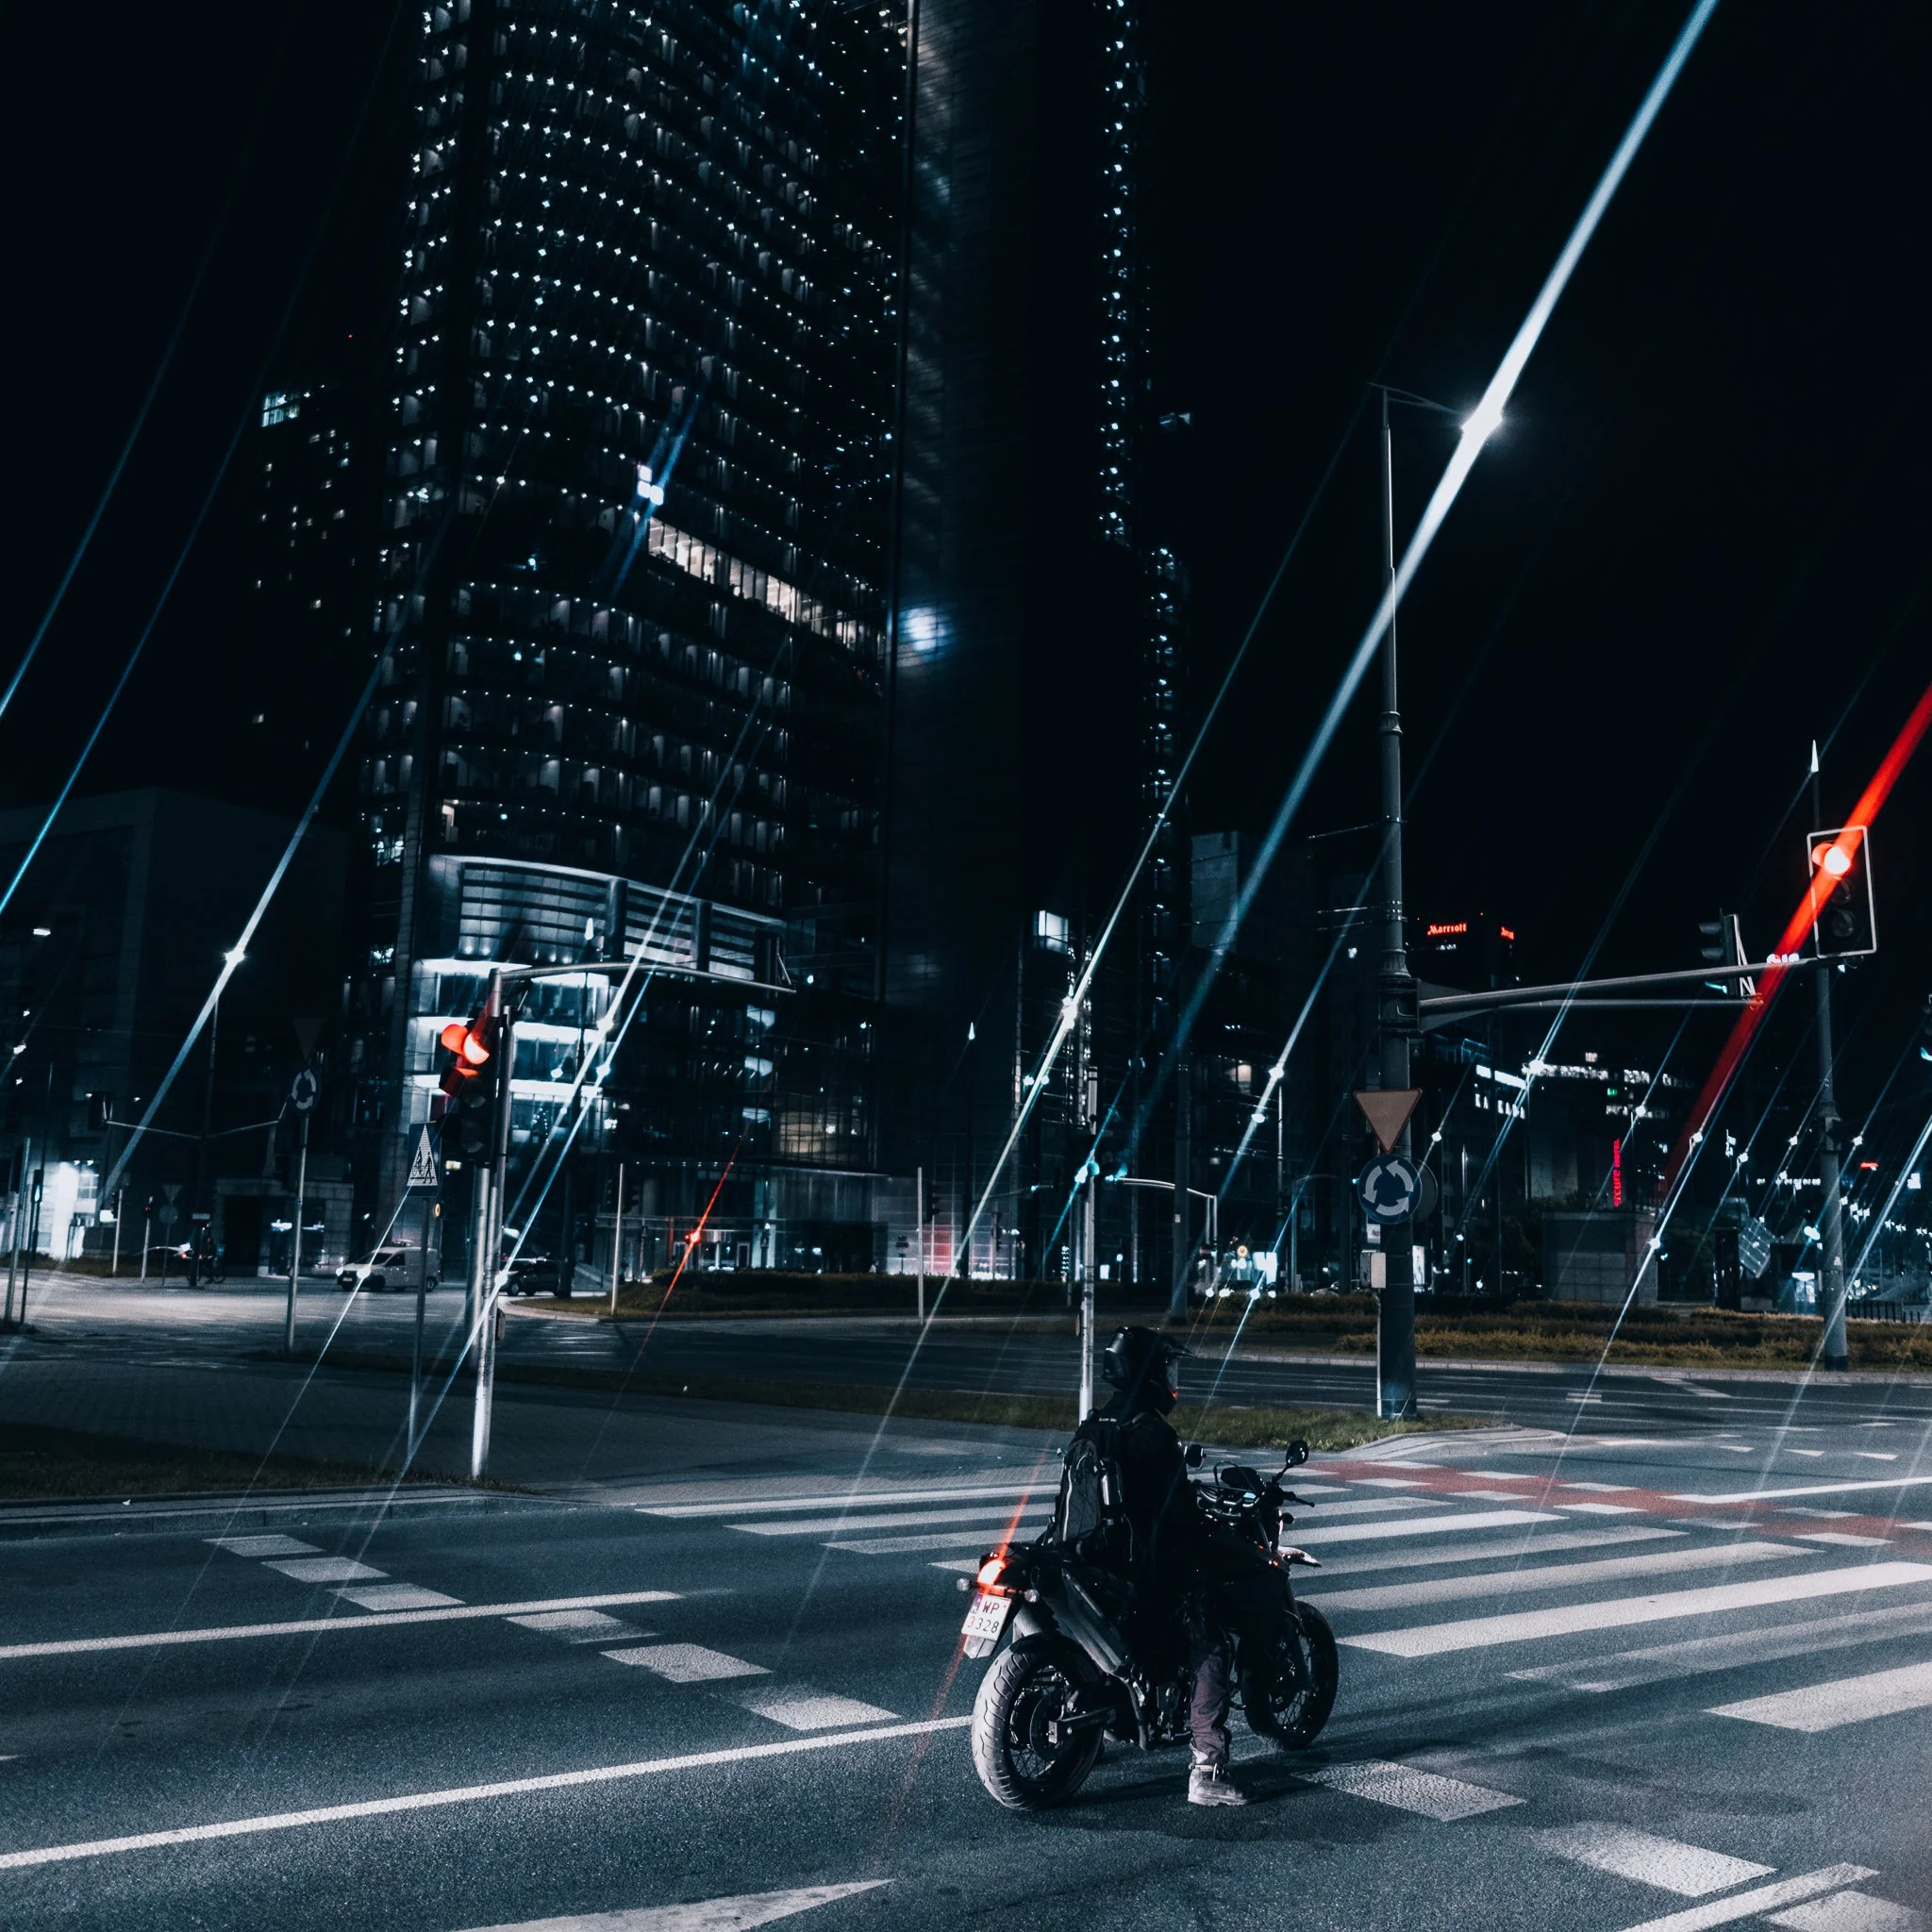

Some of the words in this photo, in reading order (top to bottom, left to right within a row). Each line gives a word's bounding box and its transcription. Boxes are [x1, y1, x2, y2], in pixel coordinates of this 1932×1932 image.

[1426, 923, 1467, 937] Marriott
[982, 1600, 1000, 1615] WP
[967, 1615, 1000, 1634] 3328
